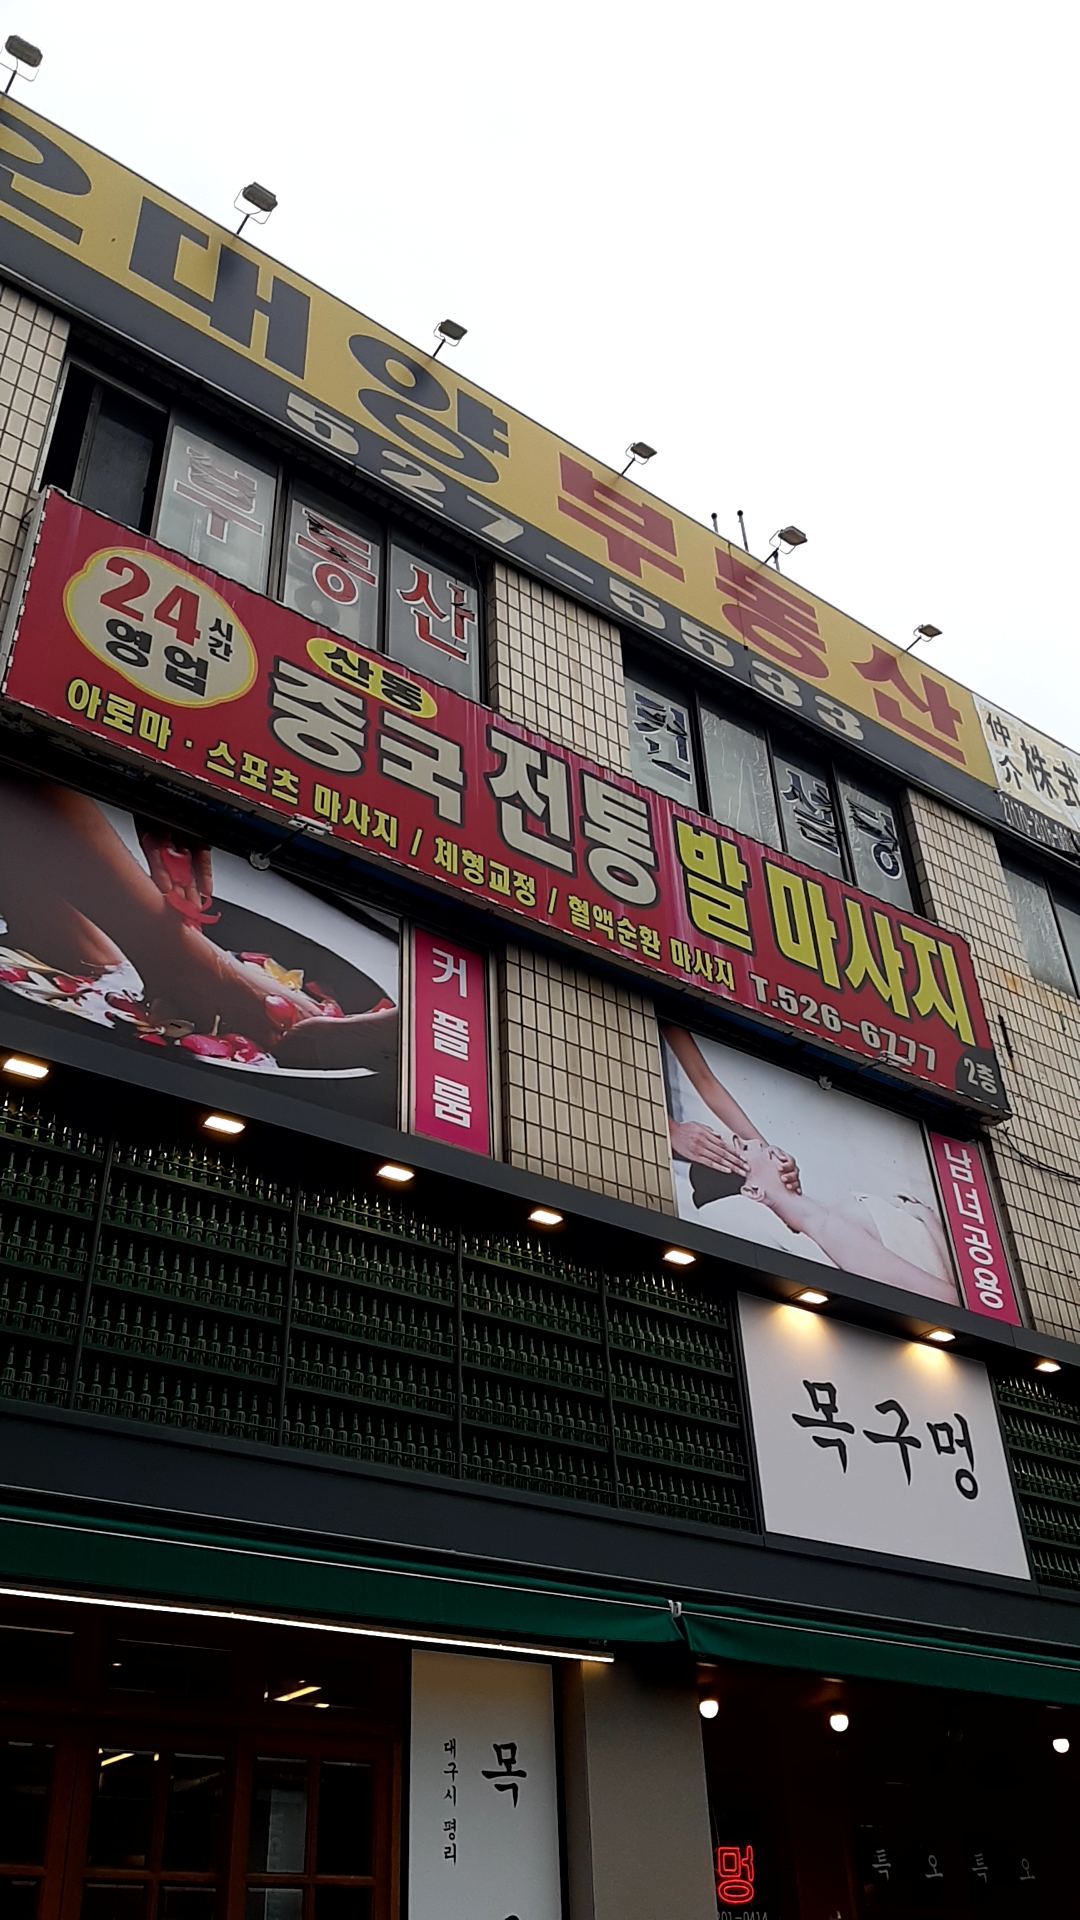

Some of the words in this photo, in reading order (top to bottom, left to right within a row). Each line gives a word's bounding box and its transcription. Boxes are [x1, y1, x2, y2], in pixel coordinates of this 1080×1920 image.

[100, 557, 201, 647] 24
[173, 446, 476, 664] 부동산
[286, 392, 864, 741] 527-5533
[208, 617, 234, 663] 시간
[557, 452, 967, 768] 부동산
[106, 618, 209, 698] 영업
[325, 646, 423, 712] 산동
[67, 678, 173, 751] 아로마
[206, 741, 299, 805] 스포츠
[314, 783, 398, 848] 마사지
[434, 837, 536, 907] 체형교정
[567, 894, 661, 960] 혈액순환
[669, 938, 737, 991] 마사지
[271, 659, 465, 826] 중국
[488, 728, 660, 905] 전통
[675, 818, 753, 953] 발
[765, 861, 975, 1047] 마사지
[431, 947, 473, 1129] 커플룸
[749, 973, 936, 1072] T.526-6777
[963, 1057, 998, 1095] 2층
[943, 1142, 1005, 1310] 남녀공용
[791, 1379, 979, 1500] 목구멍
[443, 1737, 459, 1807] 대구시
[480, 1741, 528, 1809] 목
[443, 1817, 457, 1866] 평리
[717, 1845, 755, 1904] 멍
